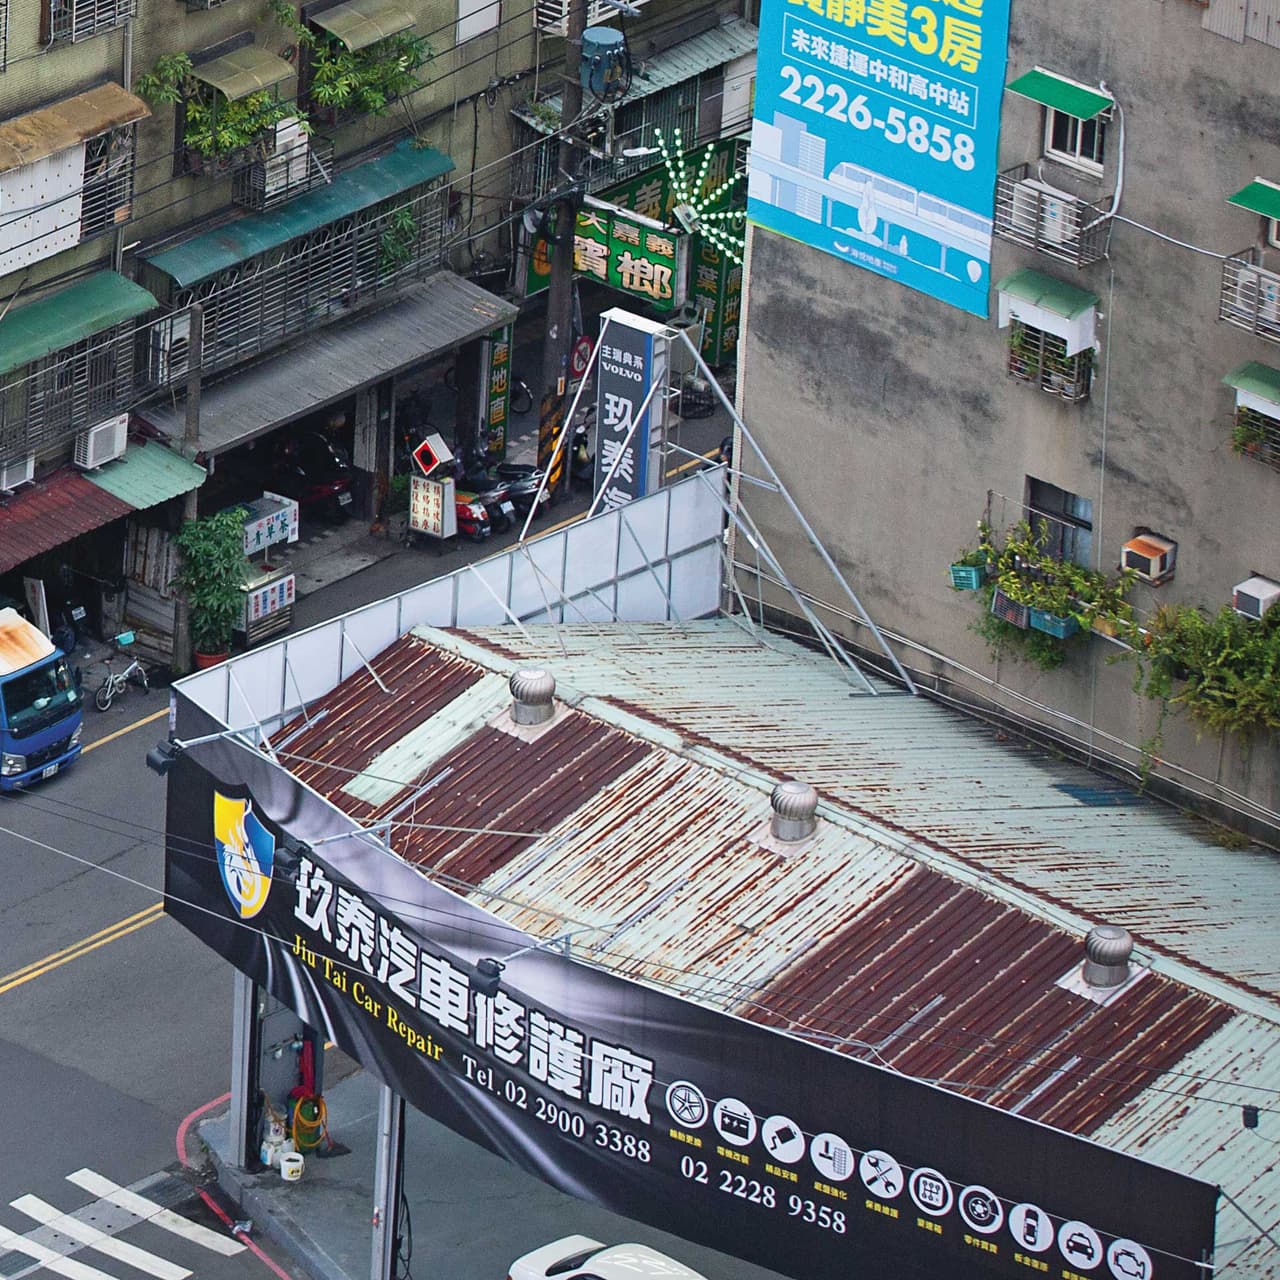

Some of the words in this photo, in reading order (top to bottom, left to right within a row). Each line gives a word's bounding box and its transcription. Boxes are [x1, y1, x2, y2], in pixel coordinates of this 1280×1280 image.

[790, 26, 971, 118] 未來捷運中和高中站
[779, 66, 977, 172] 2226-5858
[579, 211, 674, 259] 大嘉義
[601, 361, 643, 382] VOLVO
[291, 933, 317, 970] Jiu
[322, 952, 348, 994] Tai
[352, 980, 382, 1020] Car
[385, 1006, 445, 1063] Repair
[293, 854, 653, 1124] 玖泰汽車修護廠
[534, 1096, 586, 1140] 2900
[594, 1121, 652, 1164] 3388
[680, 1154, 709, 1185] 02
[718, 1169, 777, 1209] 2228
[787, 1193, 847, 1234] 9358
